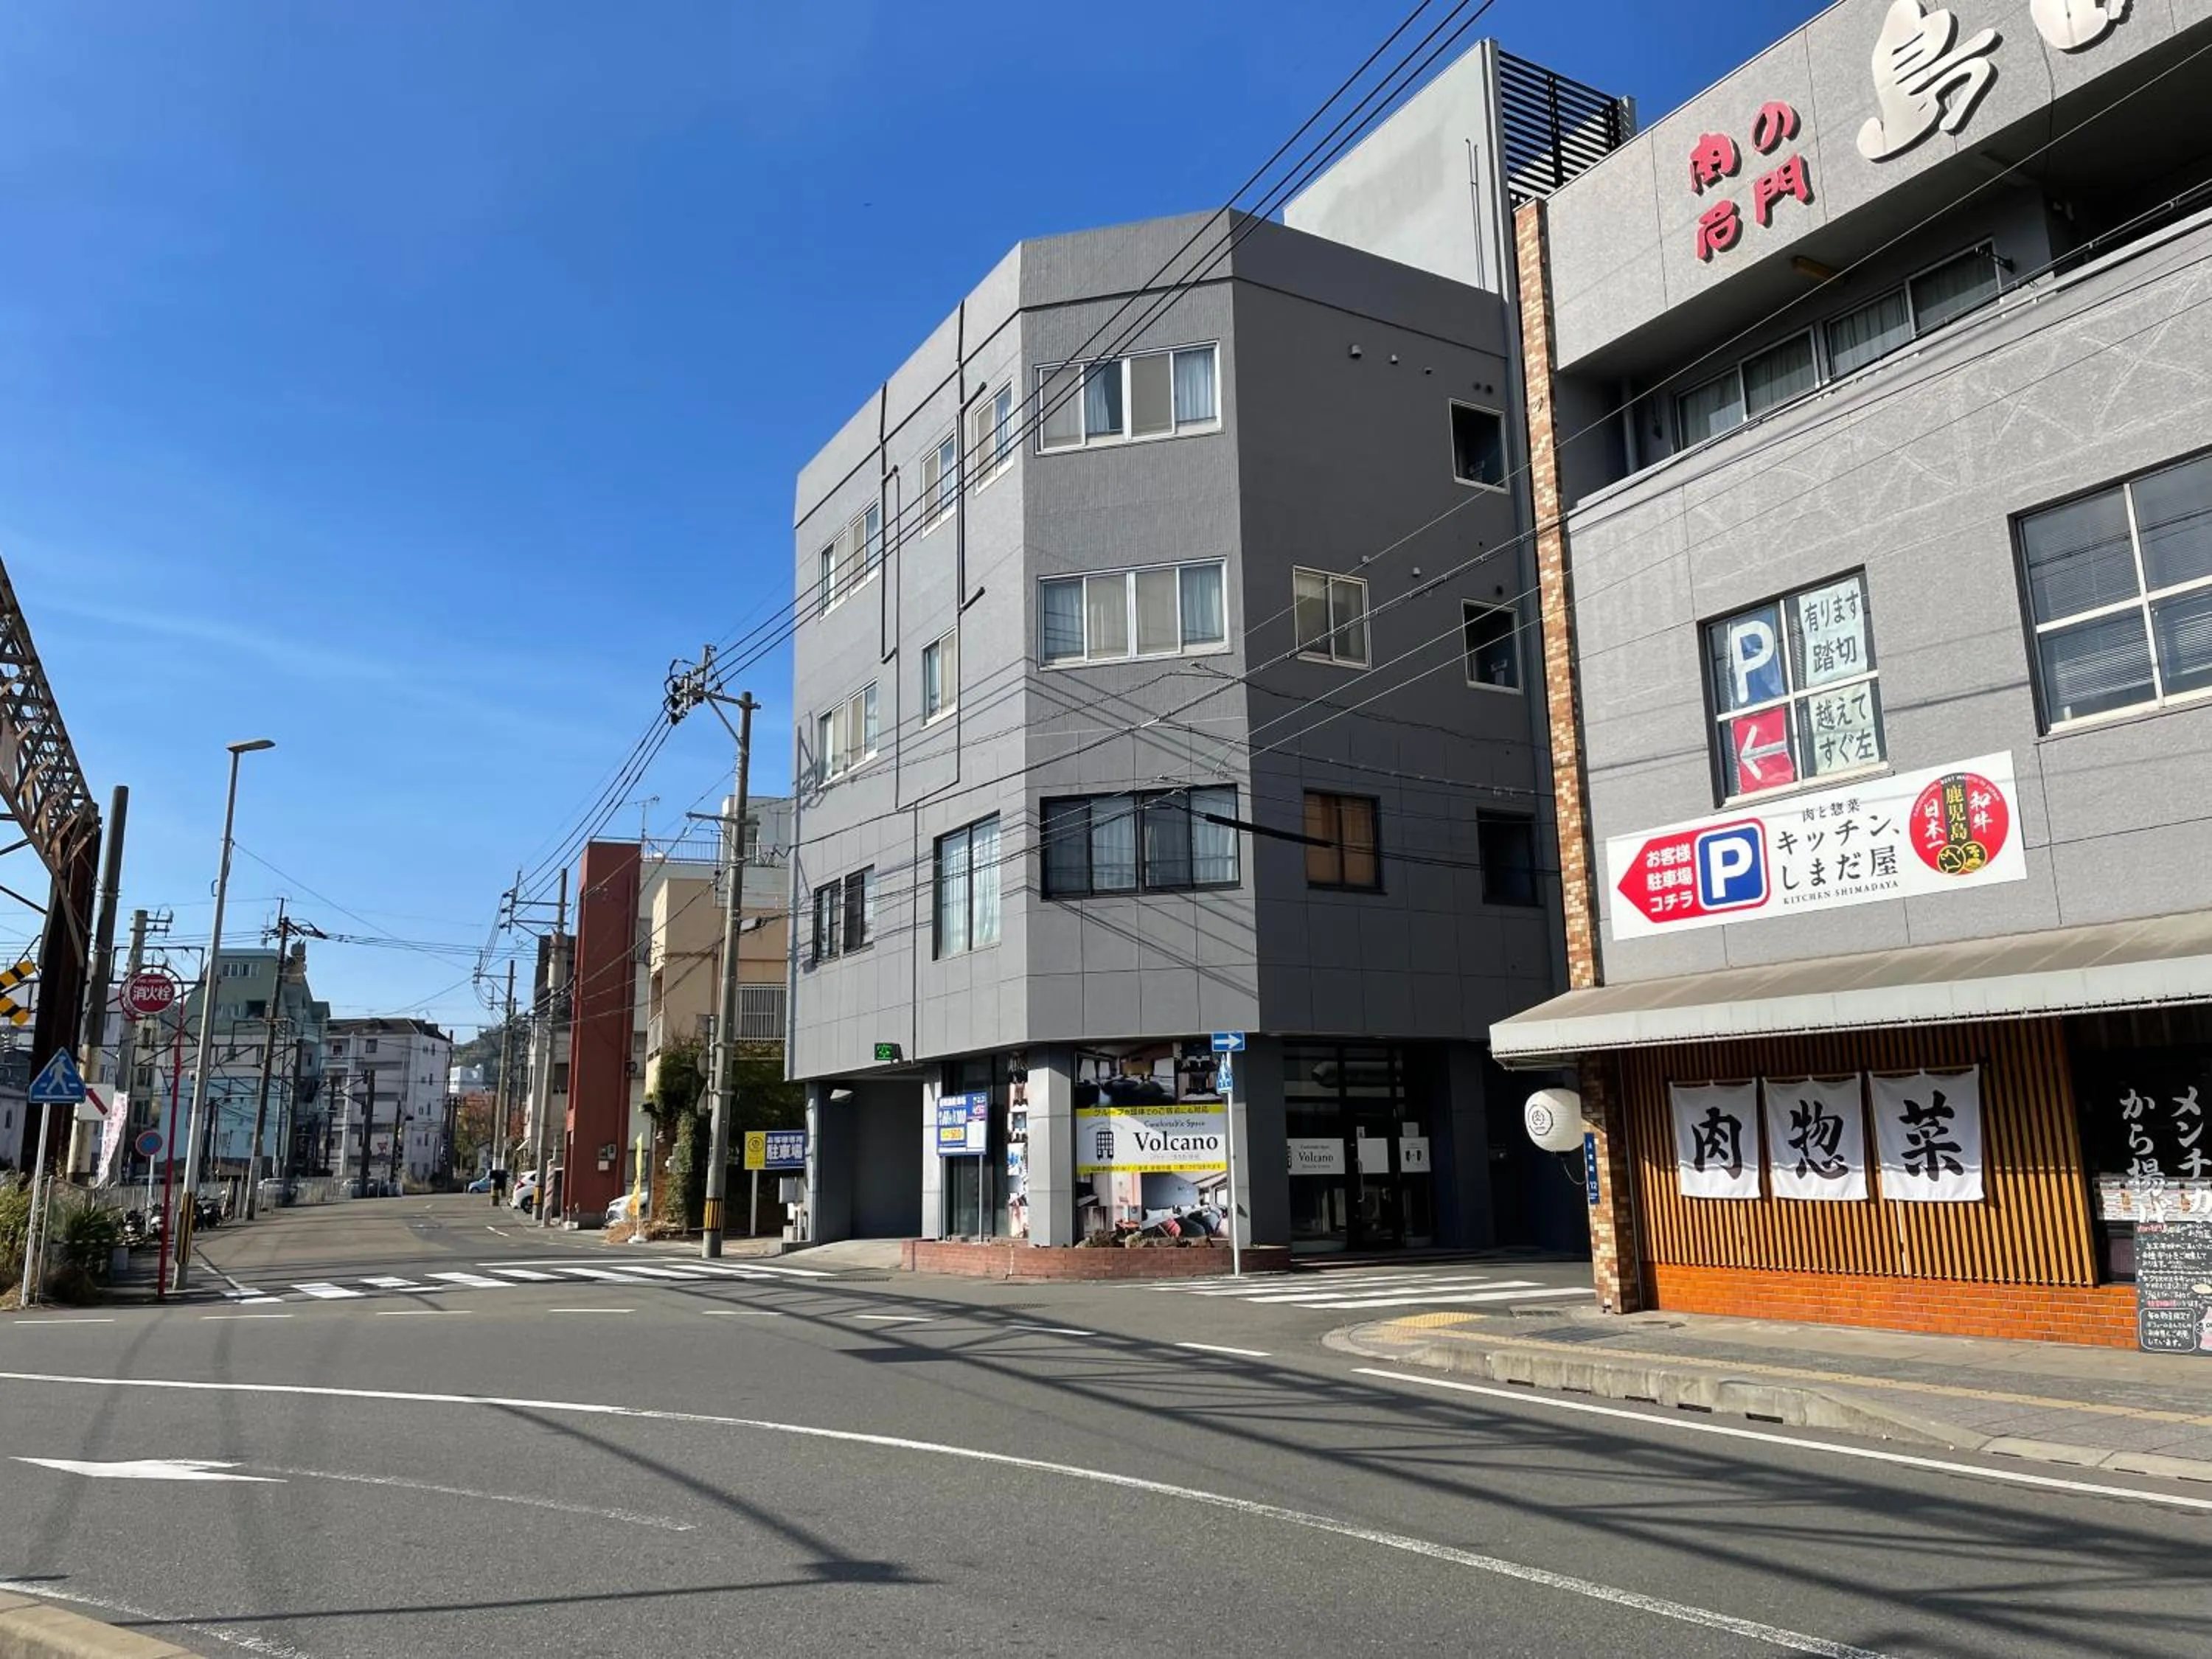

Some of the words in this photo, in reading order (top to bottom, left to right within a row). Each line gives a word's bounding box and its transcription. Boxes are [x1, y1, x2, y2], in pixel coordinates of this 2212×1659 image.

[1804, 590, 1859, 632] 有ります
[1731, 620, 1775, 703] P
[1813, 635, 1857, 673] 踏切
[1816, 692, 1866, 731] 越えて
[1819, 728, 1875, 768] すぐ左
[1802, 798, 1861, 823] 肉と惣菜
[1924, 798, 1946, 849] 日本一
[1946, 784, 1968, 841] 鹿児島
[1969, 790, 1994, 833] 和牛
[1646, 843, 1692, 868] お客様
[1708, 836, 1753, 900] P
[1781, 845, 1899, 891] しまだ屋
[1646, 866, 1693, 891] 駐車場
[1783, 891, 1832, 905] KITCHEN
[1834, 880, 1899, 898] SHIMADAYA
[1649, 890, 1694, 913] コチラ
[133, 985, 172, 1001] 消火栓
[1133, 1130, 1219, 1152] Volcano
[1691, 1107, 1743, 1179] 肉
[1788, 1099, 1849, 1179] 惣
[1899, 1089, 1964, 1181] 菜
[1298, 1151, 1334, 1164] Volcano
